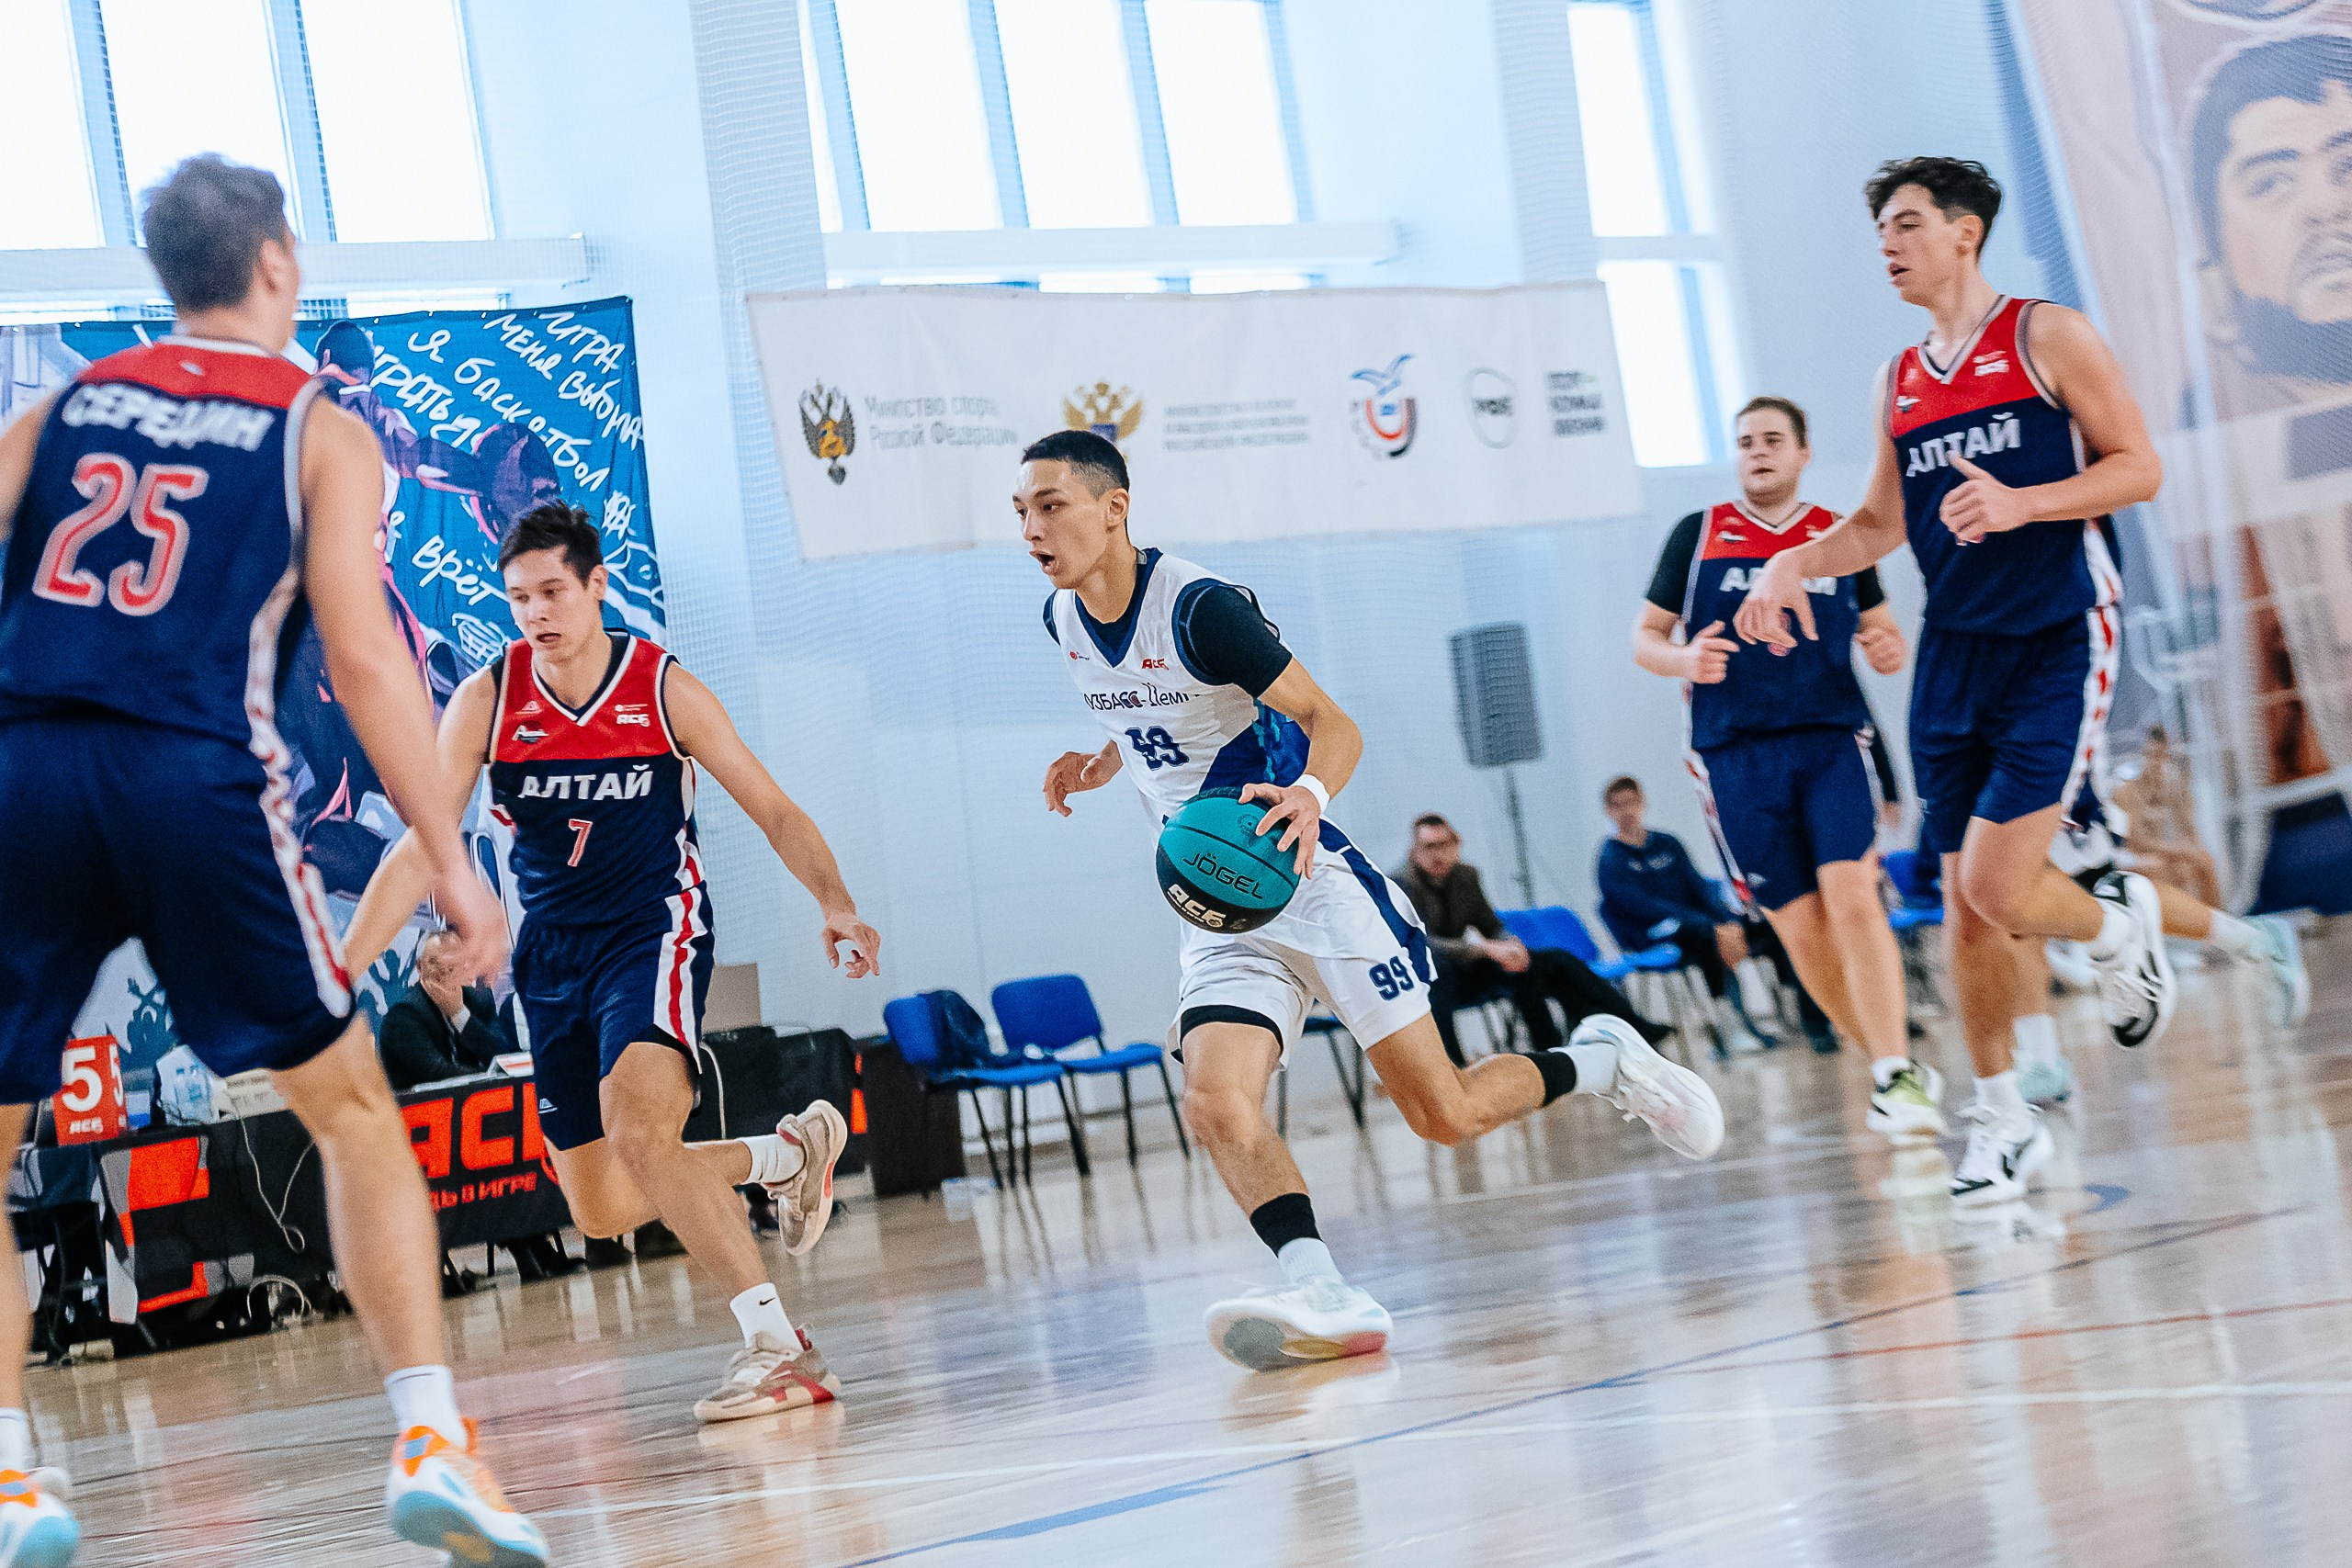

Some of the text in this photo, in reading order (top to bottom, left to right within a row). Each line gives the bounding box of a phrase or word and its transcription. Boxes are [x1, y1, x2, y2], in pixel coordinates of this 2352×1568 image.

[31, 452, 209, 616] 25
[517, 763, 653, 801] АЛТАЙ
[567, 818, 594, 867] 7
[1182, 852, 1263, 900] JÖGEL
[1369, 955, 1414, 1001] 99
[62, 1045, 103, 1112] 5
